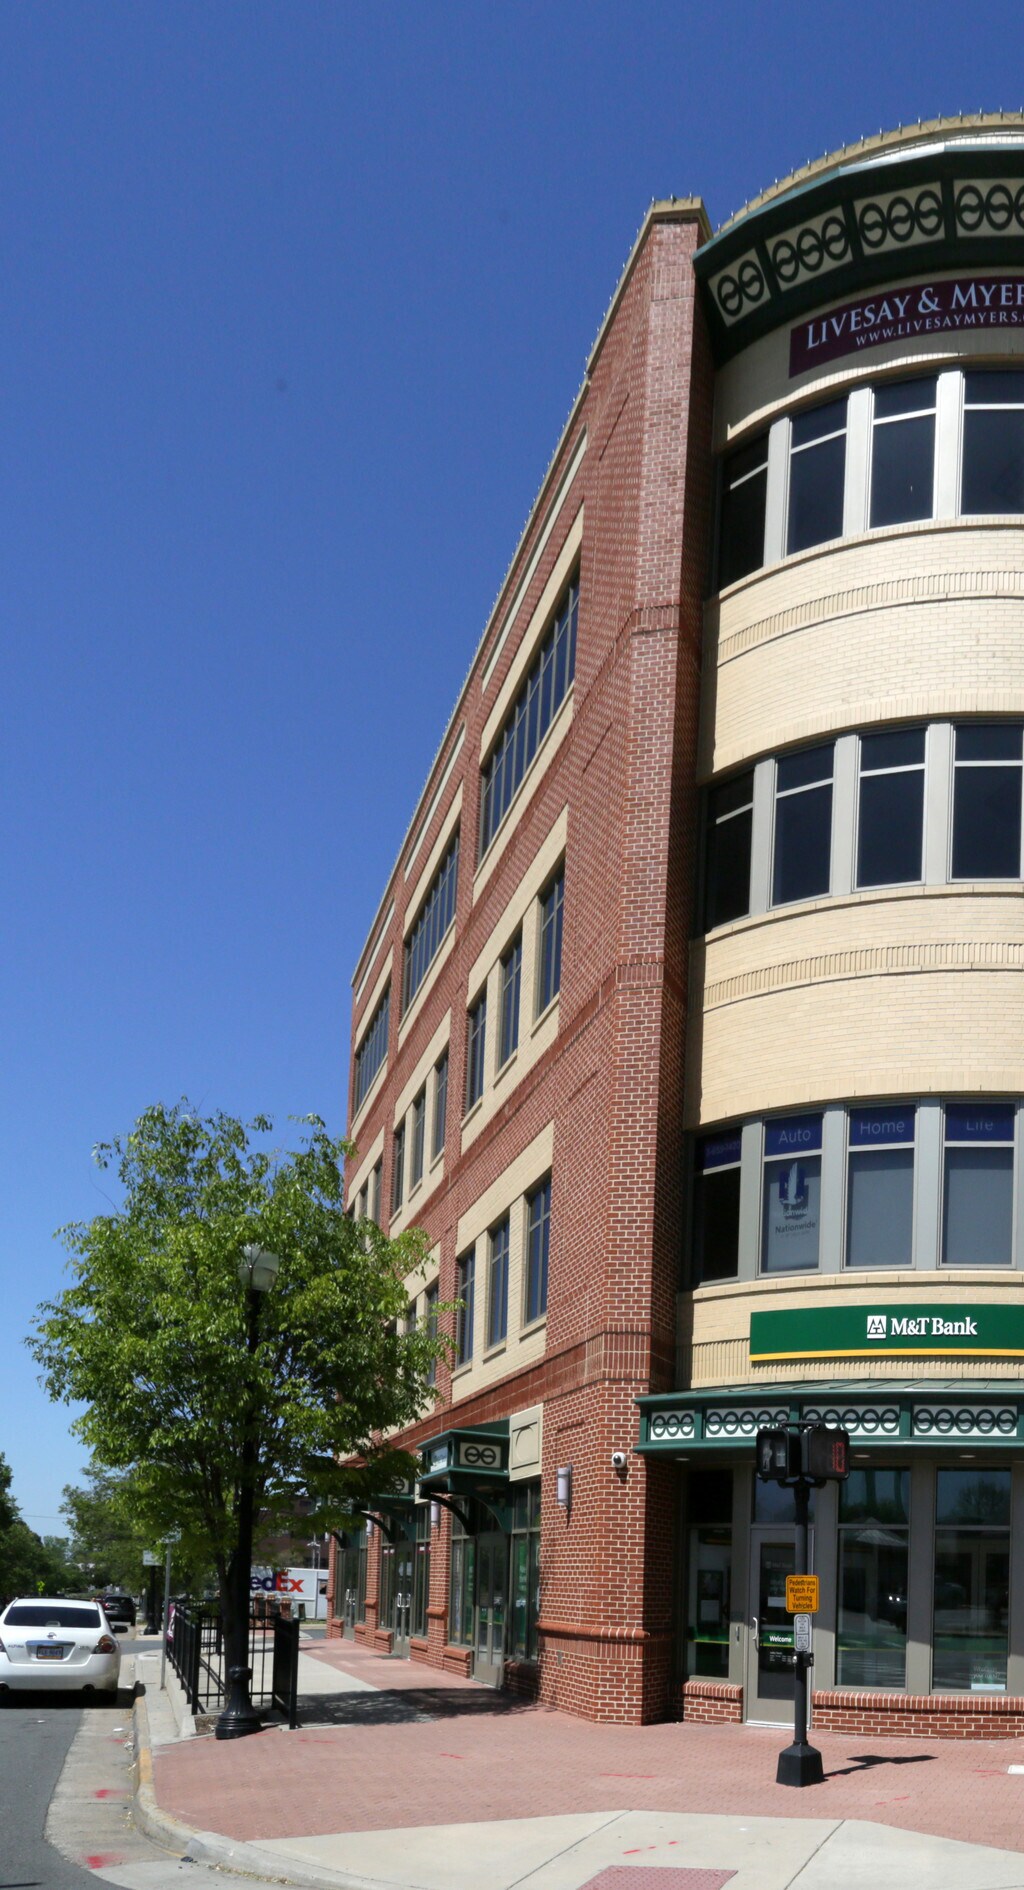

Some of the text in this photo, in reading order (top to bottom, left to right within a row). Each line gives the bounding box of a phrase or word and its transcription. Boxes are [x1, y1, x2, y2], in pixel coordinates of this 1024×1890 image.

[806, 295, 911, 349] LIVESAY
[917, 287, 942, 313] &
[860, 1121, 905, 1135] Home
[966, 1119, 994, 1131] Life
[779, 1128, 811, 1144] Auto
[890, 1316, 978, 1336] M&T Bank
[250, 1569, 304, 1593] edEx
